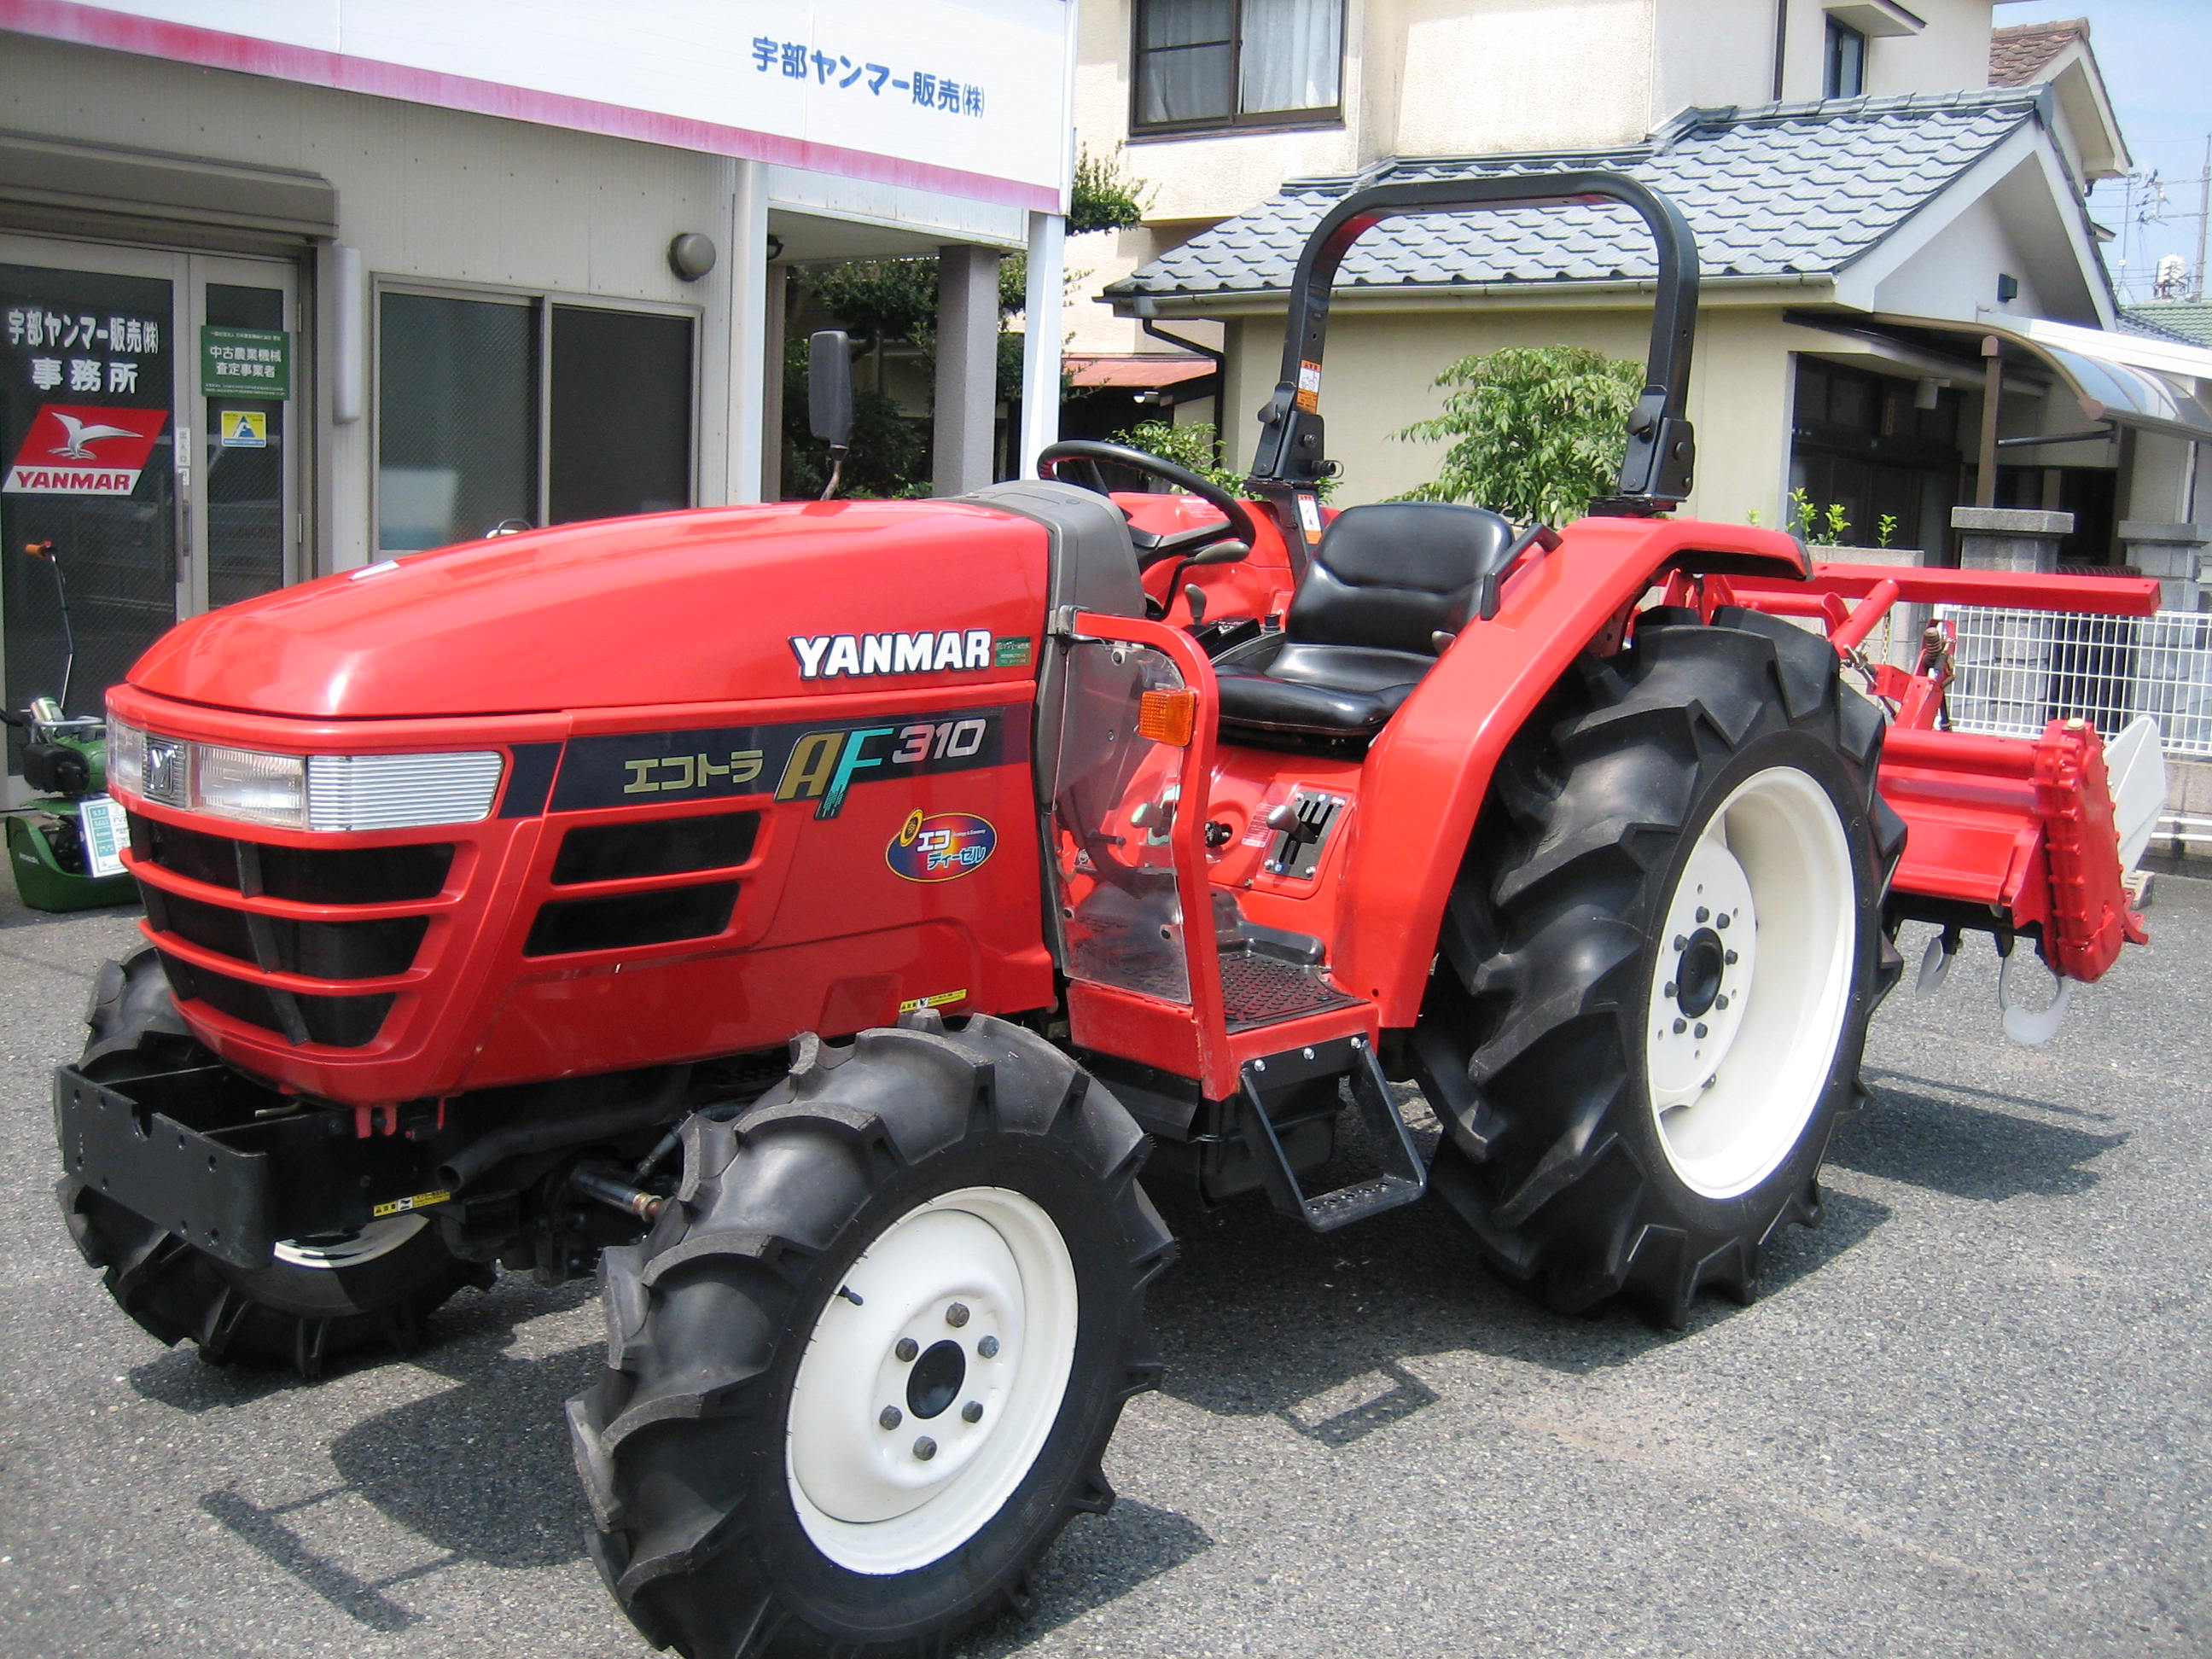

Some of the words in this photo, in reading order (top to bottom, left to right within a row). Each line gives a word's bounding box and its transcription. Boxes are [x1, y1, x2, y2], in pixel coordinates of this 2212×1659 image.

[16, 471, 131, 490] YANMAR
[790, 630, 991, 678] YANMAR
[624, 749, 763, 794] エコトラ
[917, 830, 951, 852] エコ
[927, 845, 987, 870] ディーゼル
